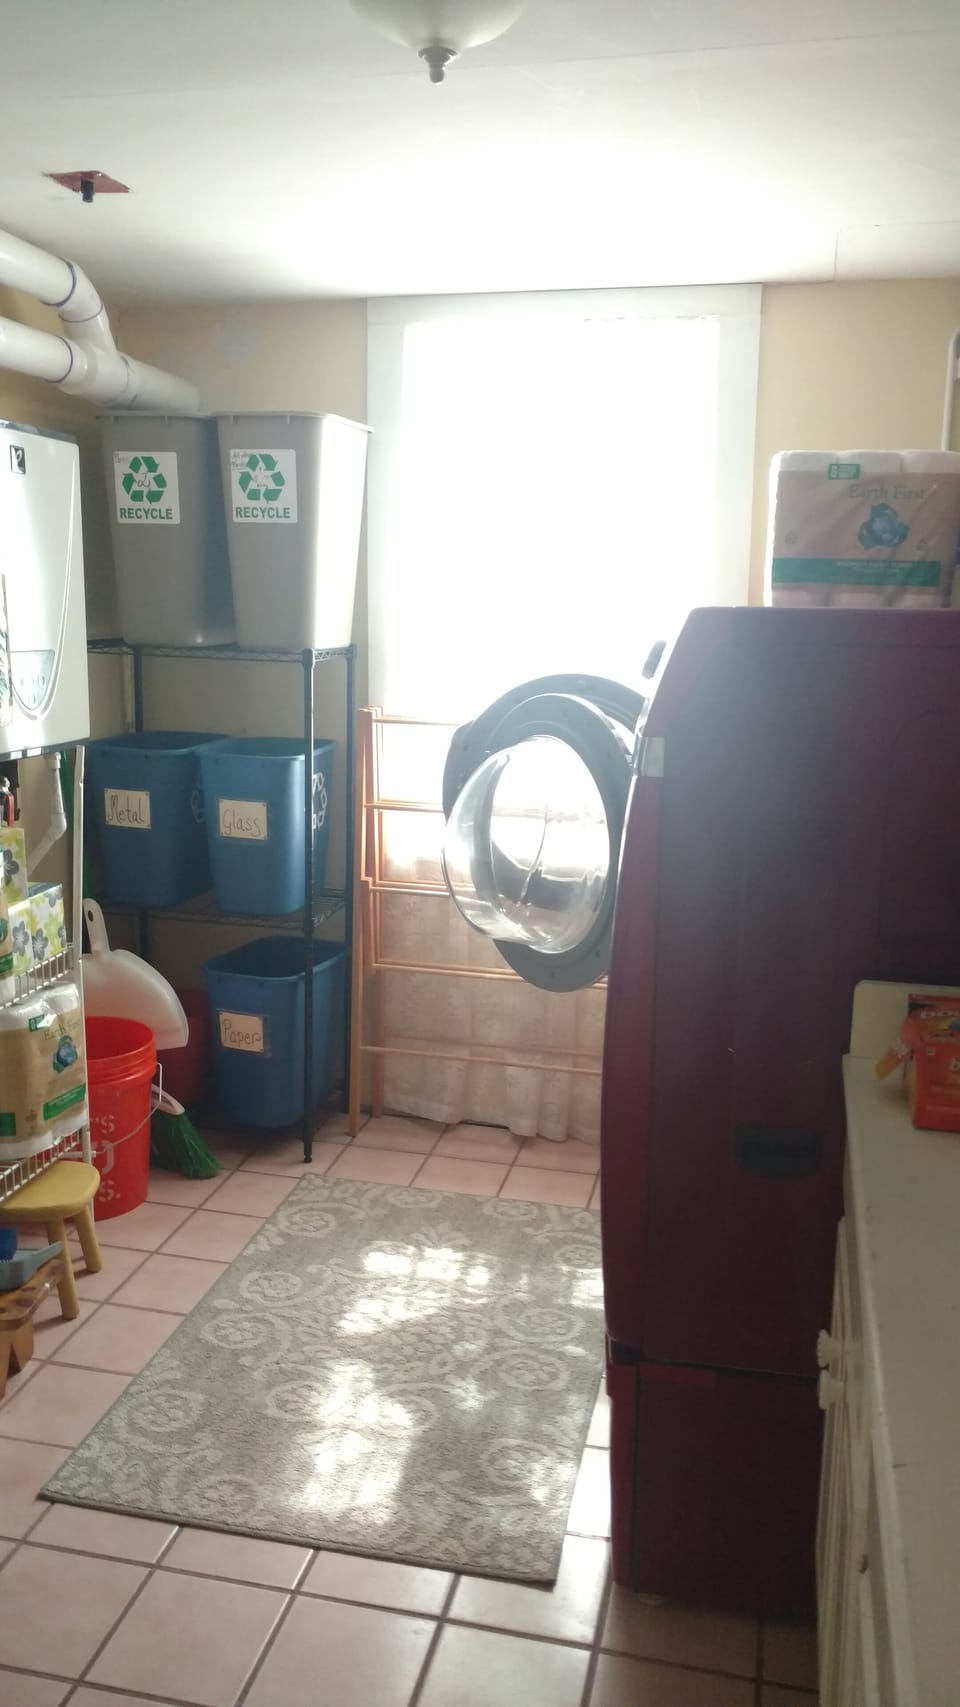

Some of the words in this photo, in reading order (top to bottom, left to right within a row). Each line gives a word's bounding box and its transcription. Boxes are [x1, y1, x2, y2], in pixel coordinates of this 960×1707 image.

[849, 481, 888, 499] Earth
[893, 485, 926, 499] First
[119, 507, 173, 520] RECYCLE
[235, 506, 291, 519] RECYCLE
[108, 794, 144, 824] Metal
[222, 808, 261, 836] Glass
[223, 1018, 261, 1048] Paper
